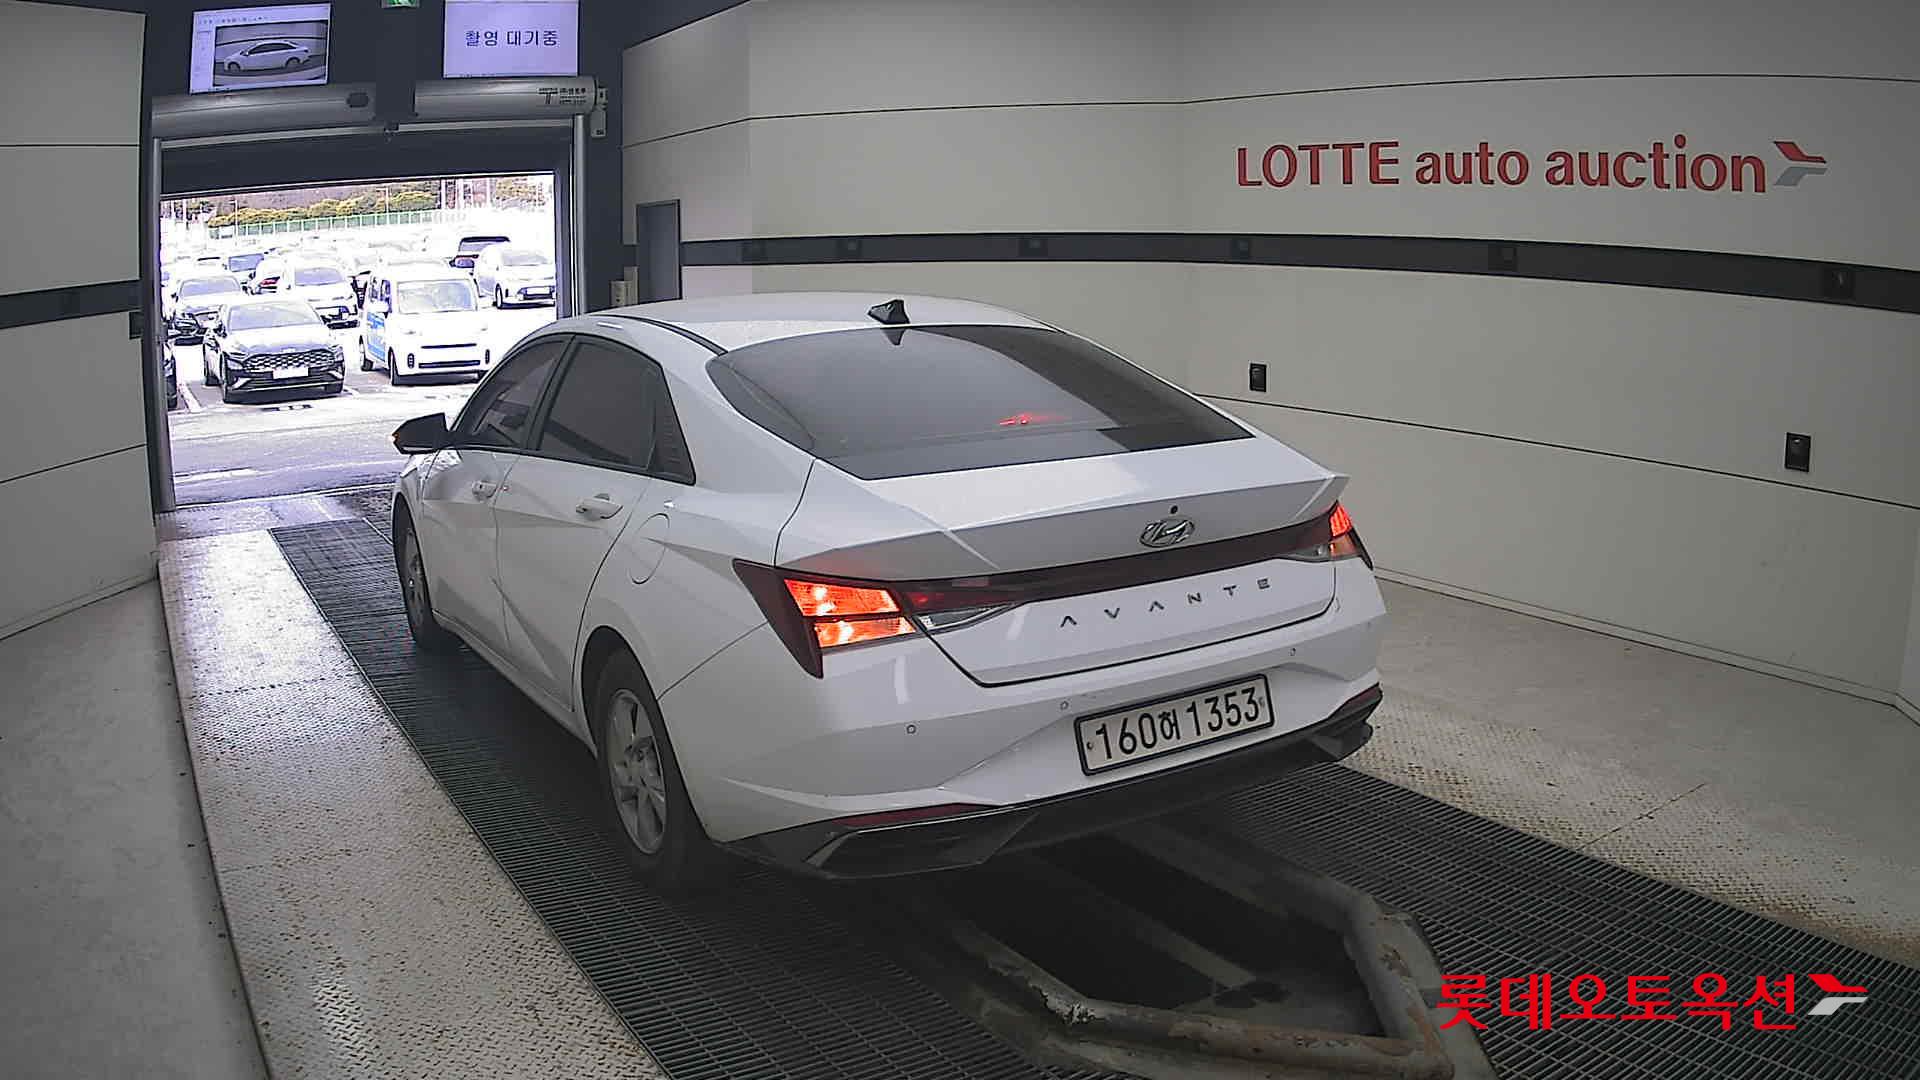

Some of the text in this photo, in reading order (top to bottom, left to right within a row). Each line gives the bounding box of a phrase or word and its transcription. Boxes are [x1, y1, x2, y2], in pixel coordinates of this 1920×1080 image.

[465, 30, 558, 47] 촬영 대기중
[1237, 136, 1765, 192] LOTTE auto auction
[1060, 578, 1270, 627] AVANTE
[1096, 687, 1259, 760] 160허 1353
